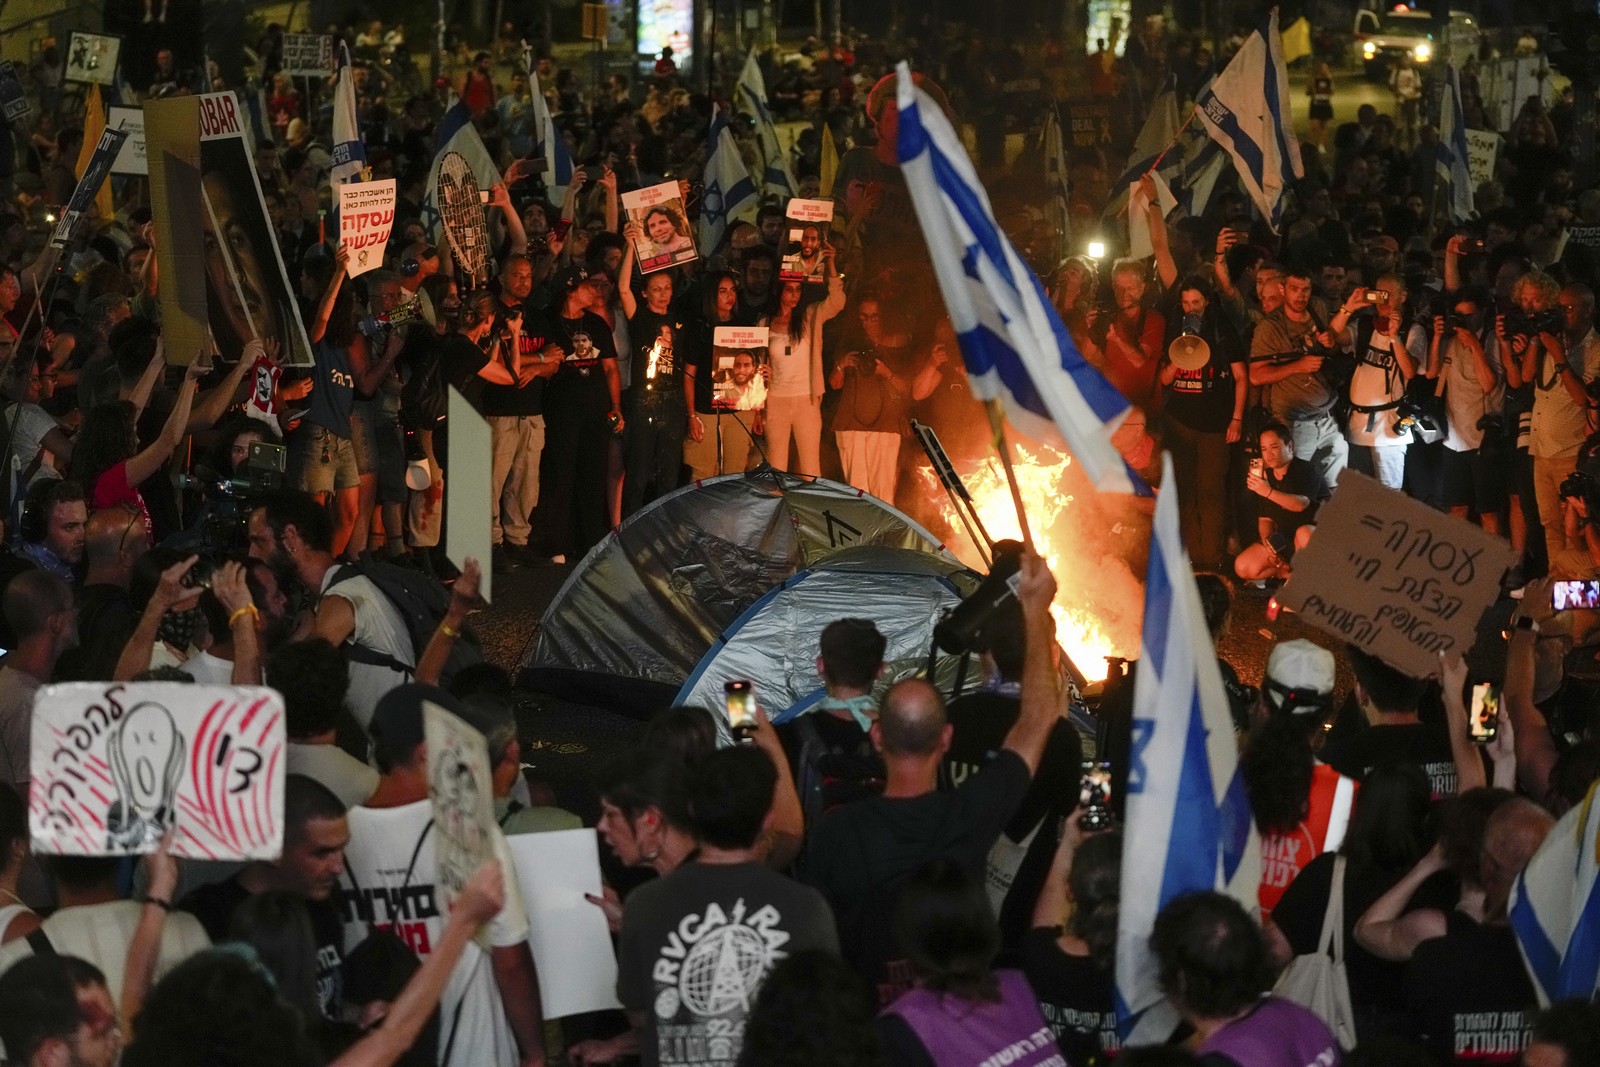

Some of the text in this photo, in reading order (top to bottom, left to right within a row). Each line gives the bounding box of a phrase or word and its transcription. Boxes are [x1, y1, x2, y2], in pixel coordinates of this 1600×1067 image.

[199, 95, 241, 136] OBAR
[333, 143, 349, 156] חופ
[343, 187, 394, 199] הן אשכרה כבר
[359, 199, 379, 208] להיות
[343, 201, 359, 210] כאן.
[342, 209, 394, 233] עסקה
[342, 229, 390, 250] עכשיו
[1348, 552, 1463, 620] הצלת חיי
[1373, 604, 1455, 653] החטופים
[1425, 762, 1456, 775] MISSI
[1261, 836, 1301, 862] צוו
[1261, 862, 1301, 888] רפו
[652, 902, 728, 985] RVCA
